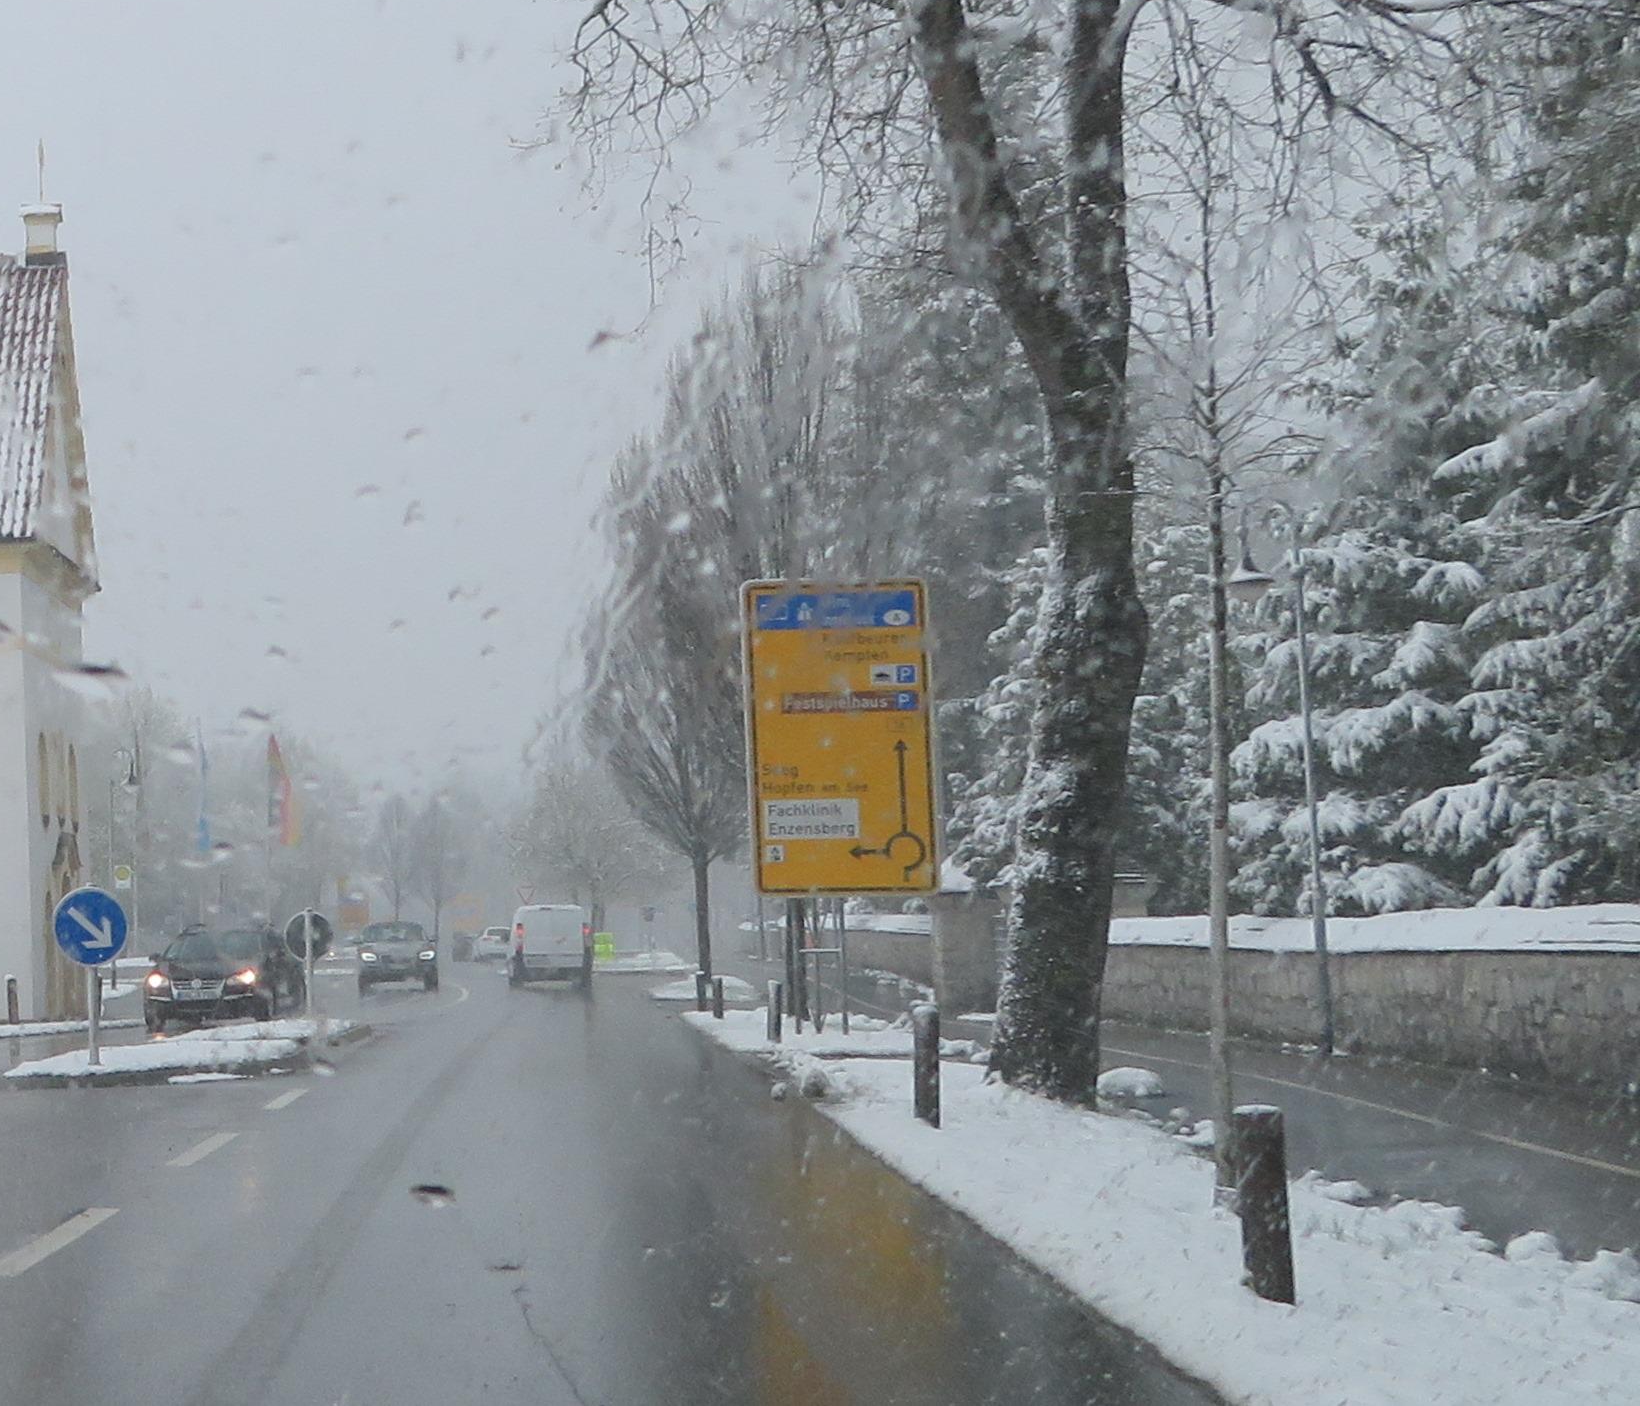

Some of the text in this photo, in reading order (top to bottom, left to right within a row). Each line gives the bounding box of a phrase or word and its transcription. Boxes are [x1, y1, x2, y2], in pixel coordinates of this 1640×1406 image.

[900, 667, 910, 681] P
[898, 693, 910, 708] P
[762, 782, 814, 796] Hopfen
[768, 804, 842, 817] Fachklinik
[768, 821, 855, 836] Enzensberg
